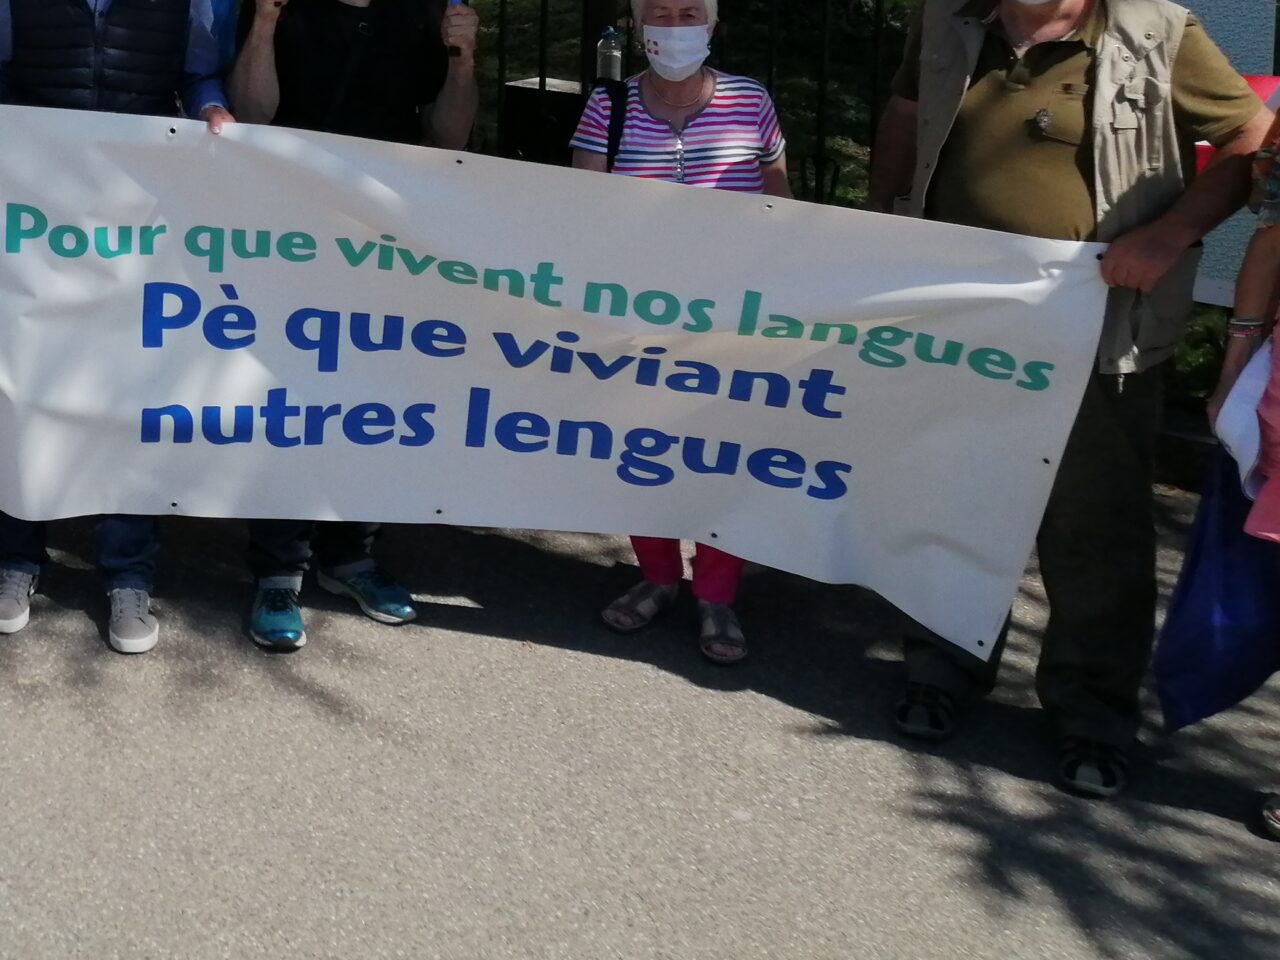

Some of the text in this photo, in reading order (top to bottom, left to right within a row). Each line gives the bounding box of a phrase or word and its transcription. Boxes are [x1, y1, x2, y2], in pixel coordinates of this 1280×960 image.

[5, 203, 1055, 391] Pour que vivent nos langues
[141, 283, 846, 418] Pè que viviant
[141, 387, 852, 499] nutres lengues
